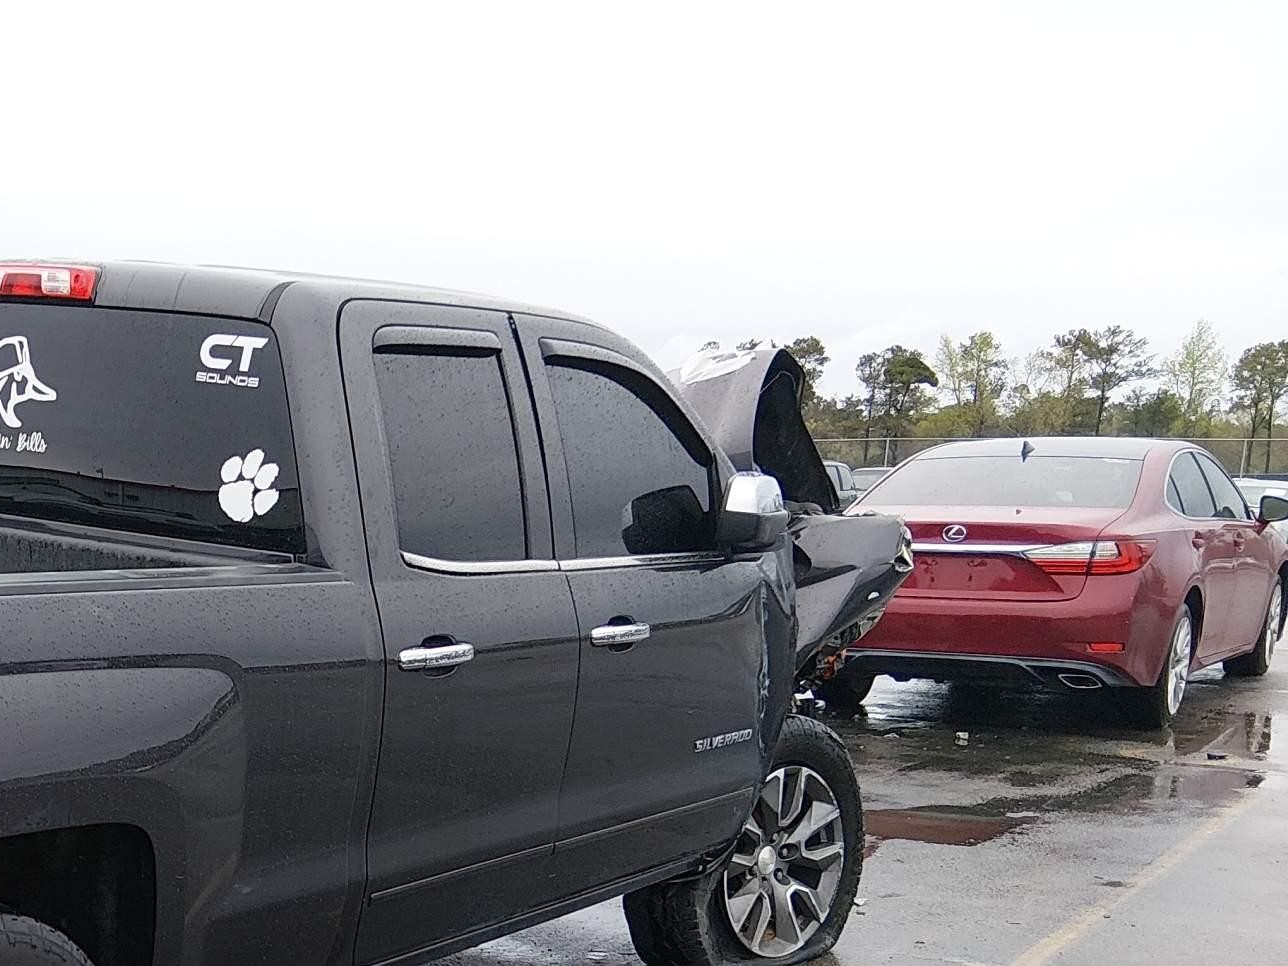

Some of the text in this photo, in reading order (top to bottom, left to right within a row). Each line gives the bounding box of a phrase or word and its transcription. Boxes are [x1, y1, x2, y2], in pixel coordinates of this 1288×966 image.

[199, 333, 269, 372] CT
[195, 371, 260, 388] SOUNDS
[16, 431, 48, 453] Bills
[694, 728, 753, 753] SILVERADO
